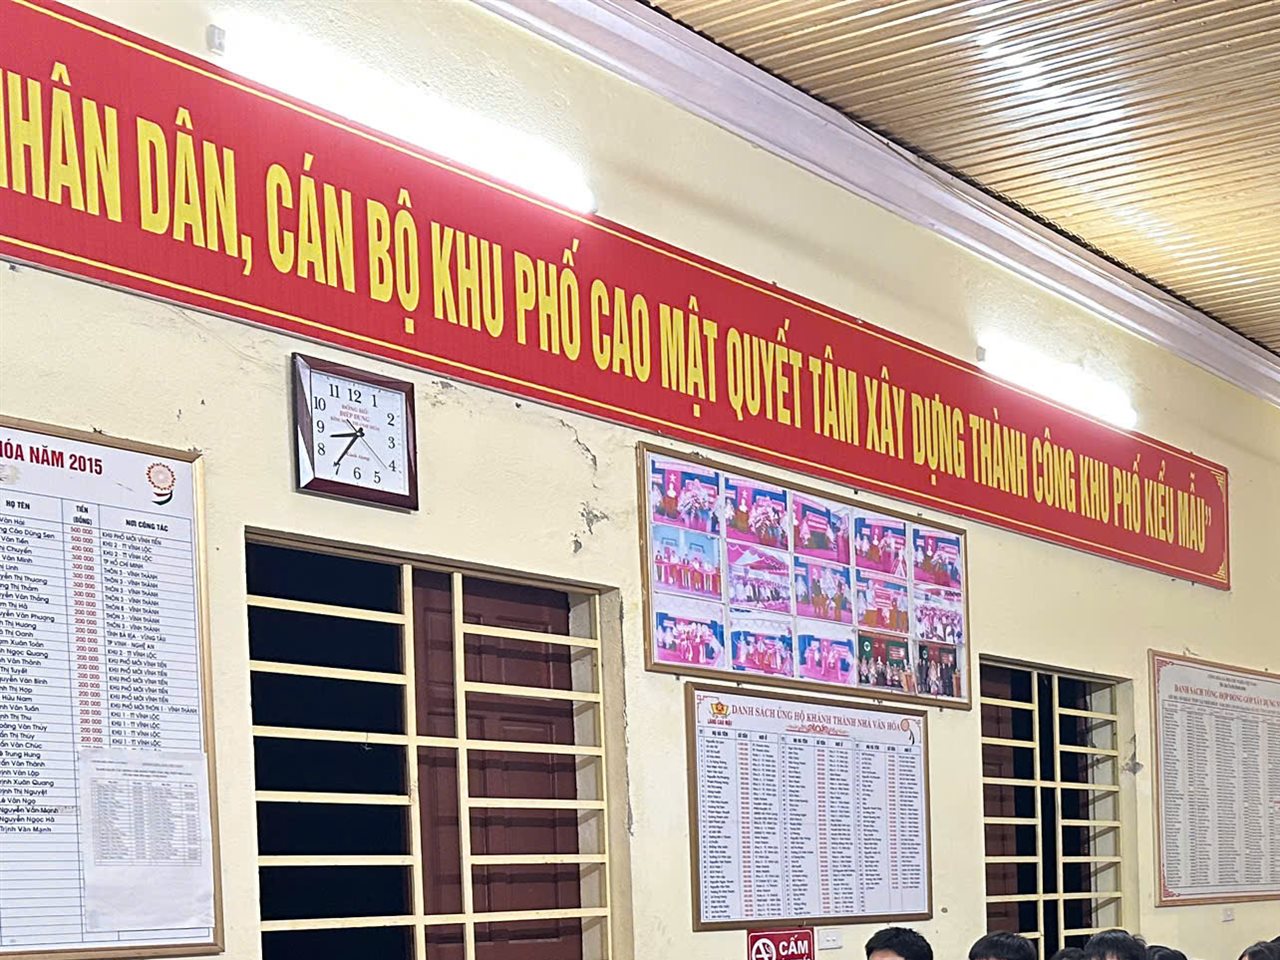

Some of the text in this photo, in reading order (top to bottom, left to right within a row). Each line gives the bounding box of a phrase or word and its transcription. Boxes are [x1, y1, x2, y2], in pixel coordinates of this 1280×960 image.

[137, 107, 253, 276] DÂN,
[265, 153, 355, 293] CÁN
[367, 189, 419, 333] BỘ
[431, 222, 503, 338] KHU
[515, 239, 580, 361] PHỐ
[590, 279, 650, 383] CAO
[660, 296, 718, 418] MẬT
[726, 319, 802, 428] QUYẾT
[809, 345, 860, 446] TÂM
[865, 367, 905, 460] XÂY
[911, 394, 966, 486] DỰNG
[969, 407, 1028, 498] THÀNH
[1032, 427, 1077, 513] CÔNG
[1079, 454, 1110, 524] KHU
[1113, 453, 1142, 534] PHỐ
[1144, 459, 1174, 544] KIỂU
[329, 384, 340, 398] 11
[348, 388, 362, 404] 12
[314, 396, 326, 411] 10
[372, 394, 378, 408] 1
[387, 412, 395, 426] 2
[316, 420, 324, 433] 9
[388, 436, 396, 449] 3
[318, 442, 326, 456] 8
[29, 444, 65, 468] NĂM
[69, 453, 103, 475] 2015
[388, 460, 397, 472] 4
[354, 467, 362, 480] 6
[374, 470, 381, 484] 5
[18, 500, 30, 510] TÊN
[42, 530, 55, 540] Sen
[16, 554, 33, 563] Minh
[5, 563, 19, 571] Linh
[14, 629, 34, 638] Oanh
[25, 648, 49, 658] Quang
[16, 694, 32, 702] Nam
[732, 704, 754, 716] DANH
[20, 713, 32, 721] Thu
[4, 749, 23, 758] Trung
[0, 777, 12, 785] rịnh
[31, 778, 54, 787] Quang
[0, 787, 13, 795] rịnh
[779, 934, 808, 956] CẤM
